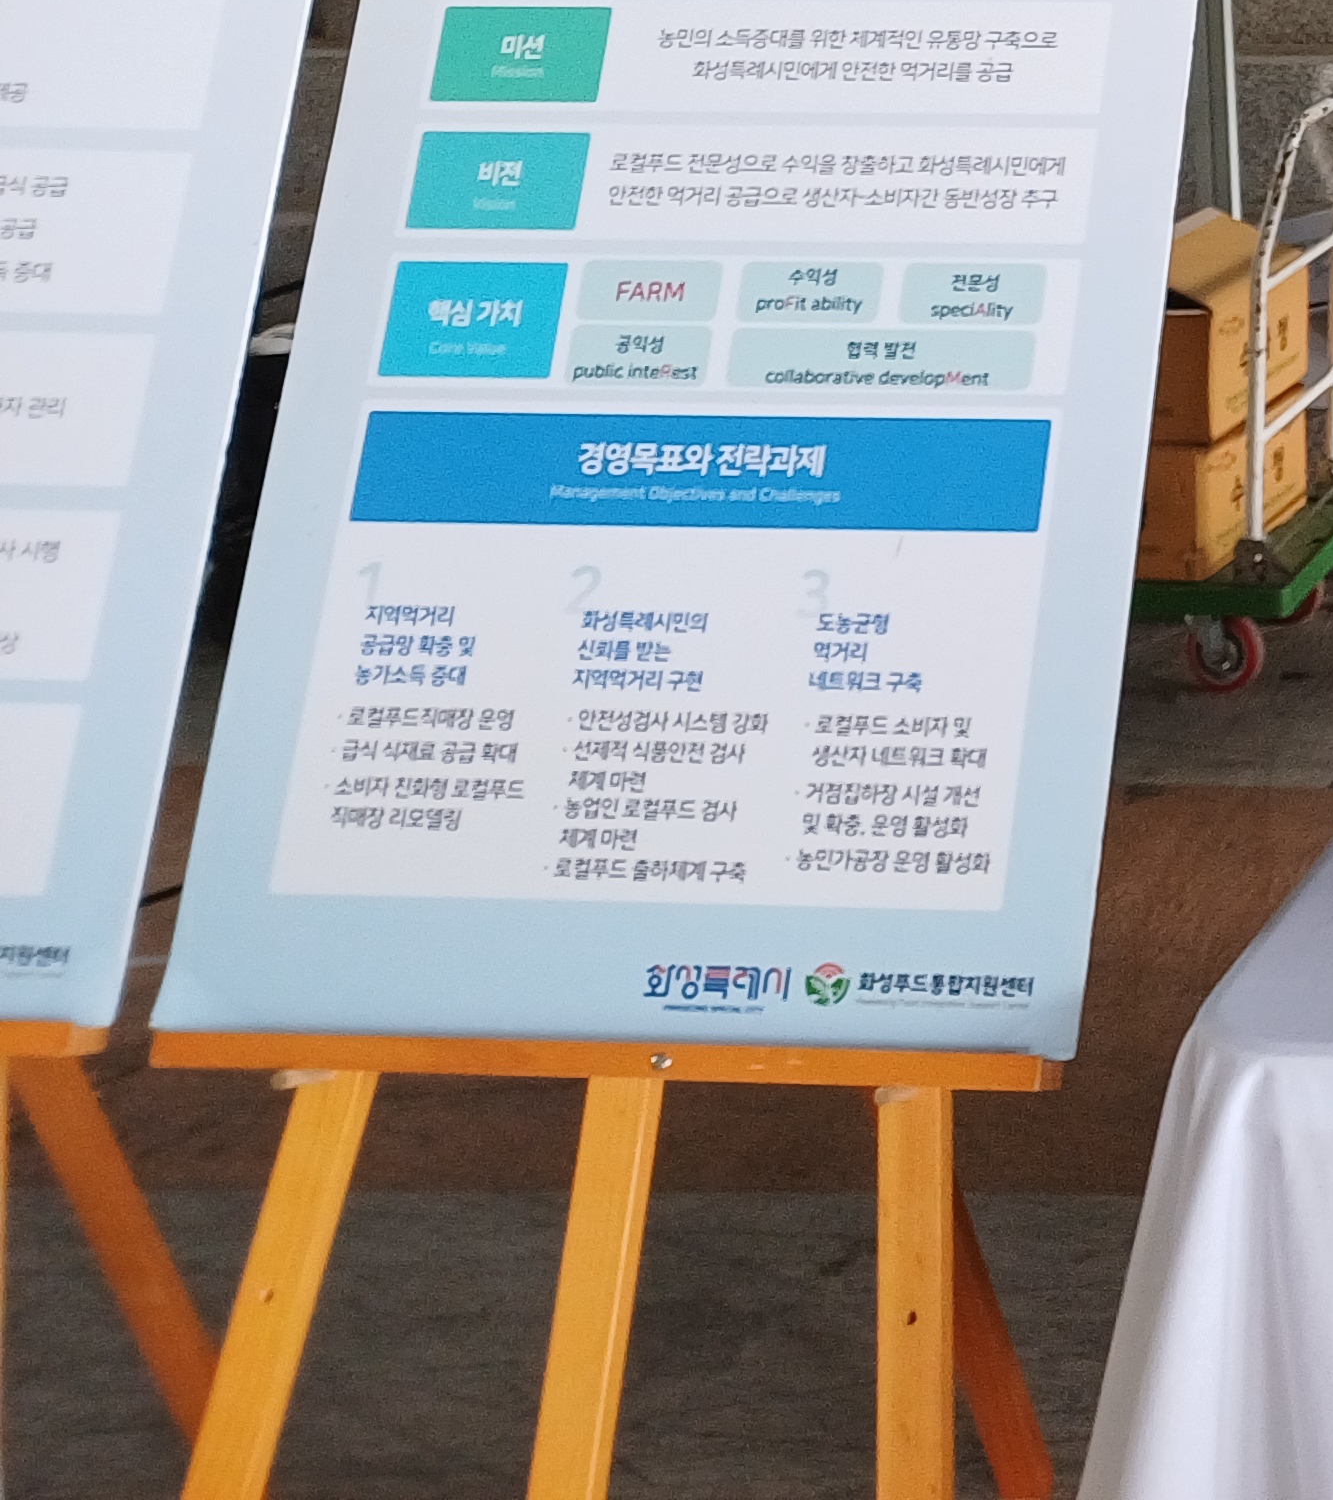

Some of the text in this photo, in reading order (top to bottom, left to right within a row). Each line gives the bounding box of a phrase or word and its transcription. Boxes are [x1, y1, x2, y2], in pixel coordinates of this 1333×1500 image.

[500, 33, 546, 61] 미션
[810, 28, 847, 49] 위한
[976, 62, 1014, 84] 공급
[477, 159, 524, 188] 비전
[615, 280, 687, 303] FARM
[811, 294, 864, 316] ability
[428, 299, 524, 328] 핵심 가치
[572, 364, 625, 382] public
[764, 369, 875, 386] collaborative
[578, 443, 828, 479] 경영목표와 전략과제
[358, 561, 383, 605] 1
[563, 565, 602, 614] 2
[643, 964, 792, 1002] 화성특례시
